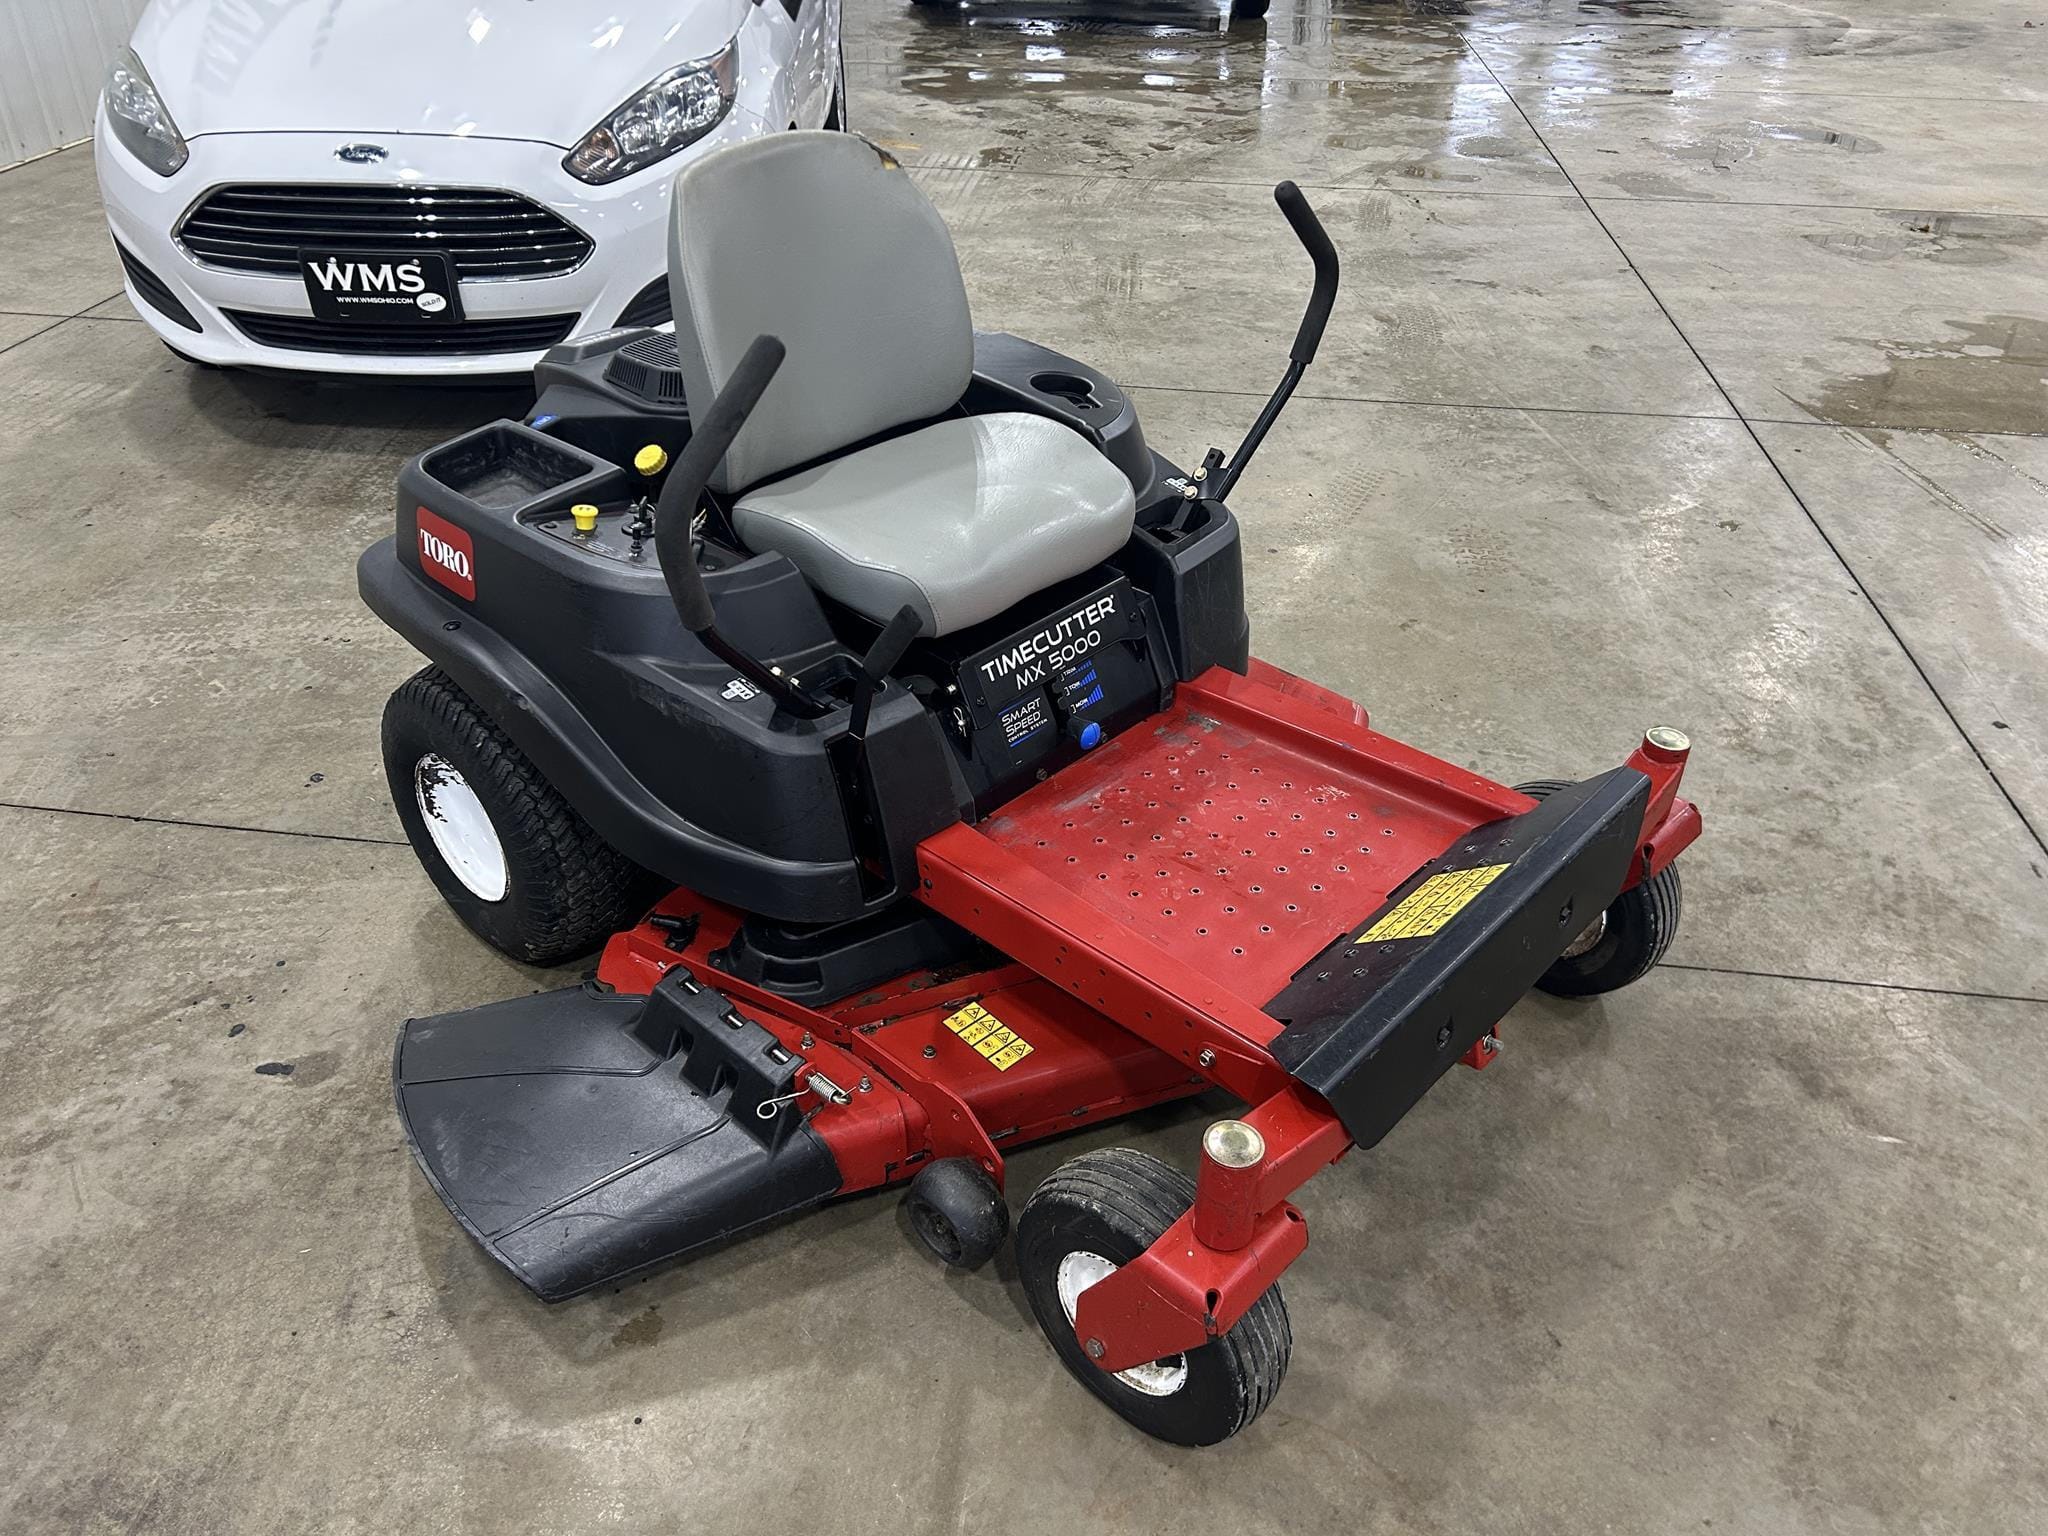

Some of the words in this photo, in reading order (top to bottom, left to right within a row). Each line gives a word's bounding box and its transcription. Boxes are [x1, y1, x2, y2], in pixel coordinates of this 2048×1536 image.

[307, 262, 426, 293] WMS
[336, 295, 414, 305] WWW.WMSOHIO.COM
[981, 600, 1116, 682] TIMECUTTER
[1015, 660, 1046, 690] MX
[1049, 630, 1101, 670] 5000
[1001, 697, 1041, 727] SMART
[1005, 711, 1041, 738] SPEED
